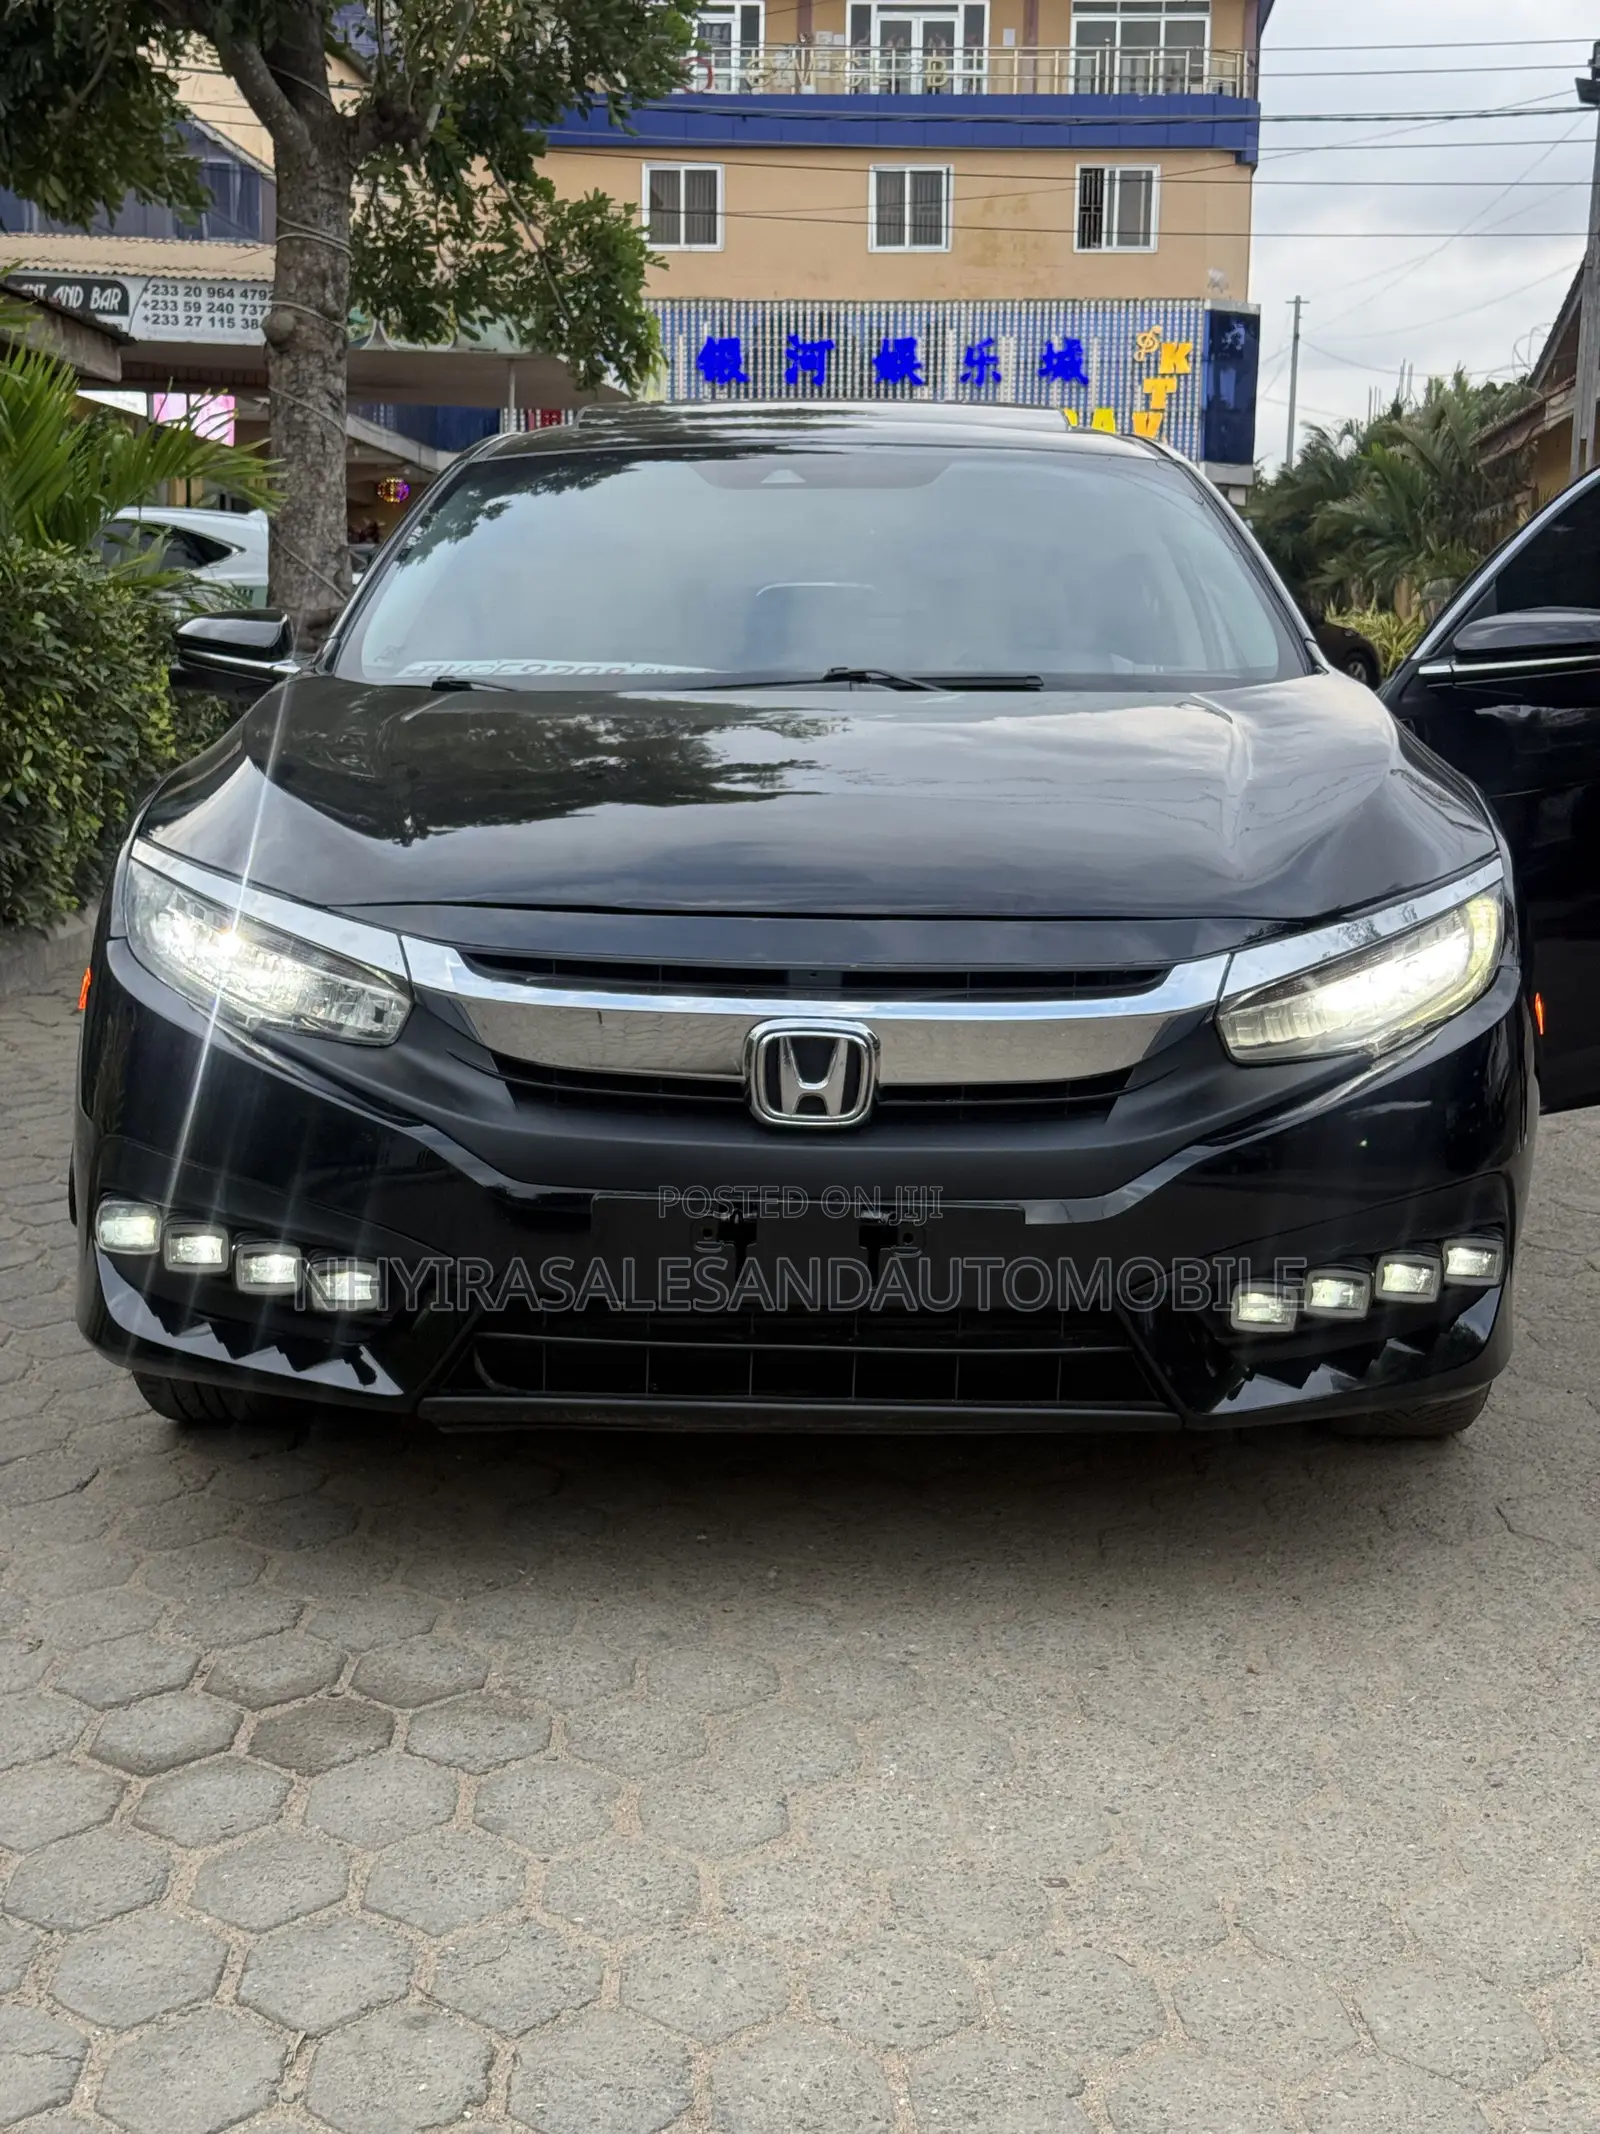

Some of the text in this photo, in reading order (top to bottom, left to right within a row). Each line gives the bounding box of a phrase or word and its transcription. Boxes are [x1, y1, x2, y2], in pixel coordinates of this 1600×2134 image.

[52, 284, 84, 309] AND
[90, 286, 122, 311] BAR
[184, 286, 202, 297] 20
[207, 287, 235, 299] 964
[141, 300, 272, 316] +233 59 240 737
[142, 314, 263, 330] +233 27 115 38
[697, 334, 1089, 387] 银河娱乐城
